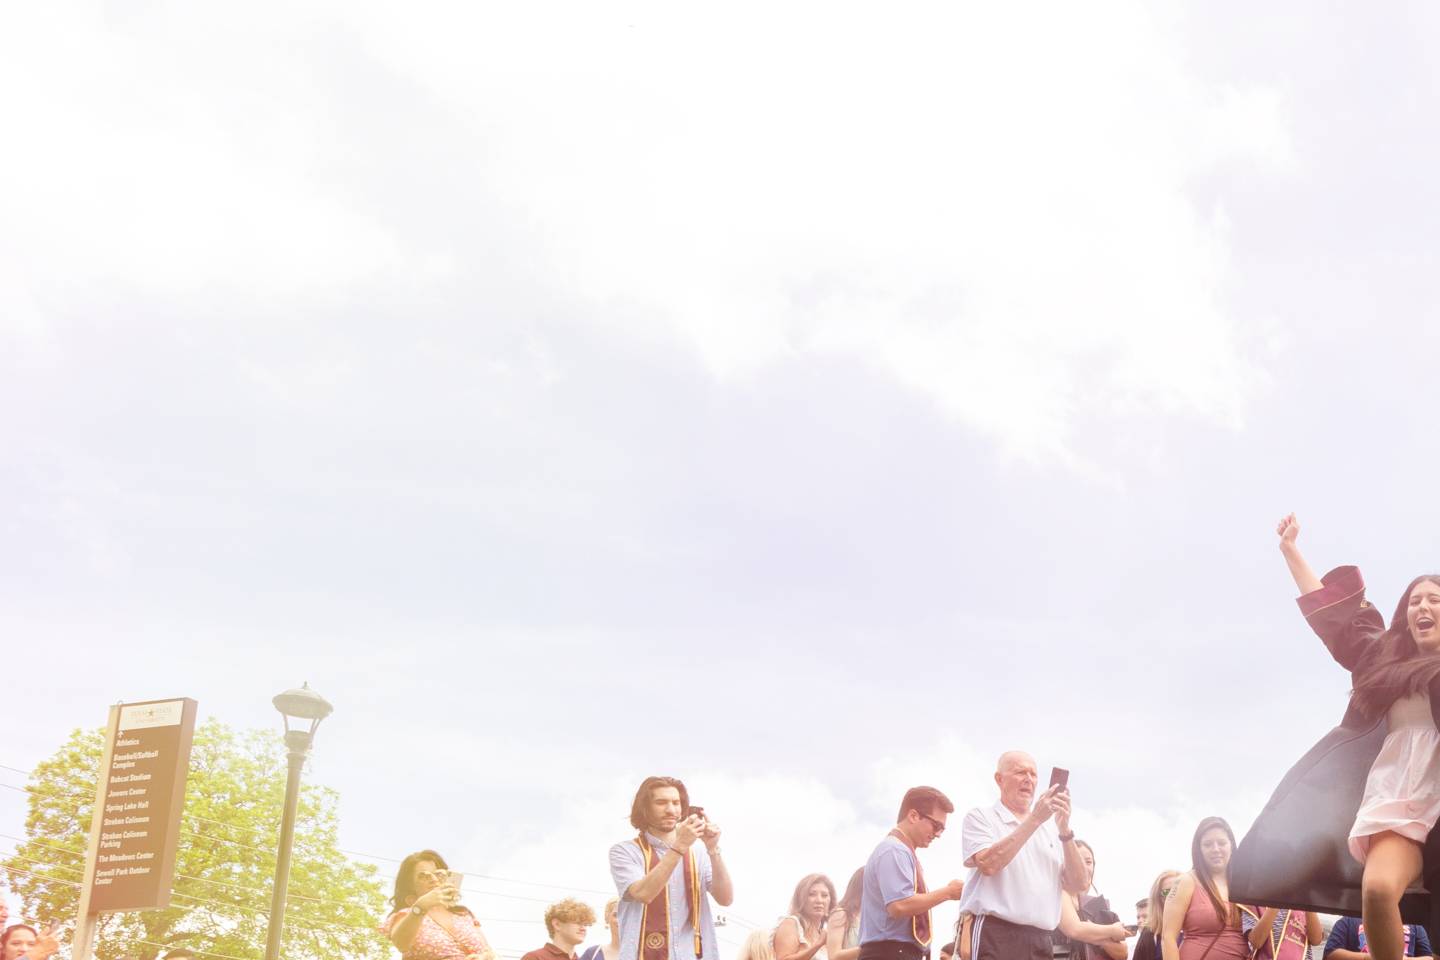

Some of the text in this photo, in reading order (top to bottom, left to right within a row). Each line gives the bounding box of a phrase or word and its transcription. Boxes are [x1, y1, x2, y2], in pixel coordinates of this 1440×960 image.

[116, 739, 140, 747] Athletics
[114, 750, 159, 761] Baseball/Softball
[130, 774, 151, 782] Stadium
[105, 804, 123, 813] Spring
[124, 802, 137, 810] Lake
[100, 840, 121, 849] Parking
[115, 868, 128, 876] Park
